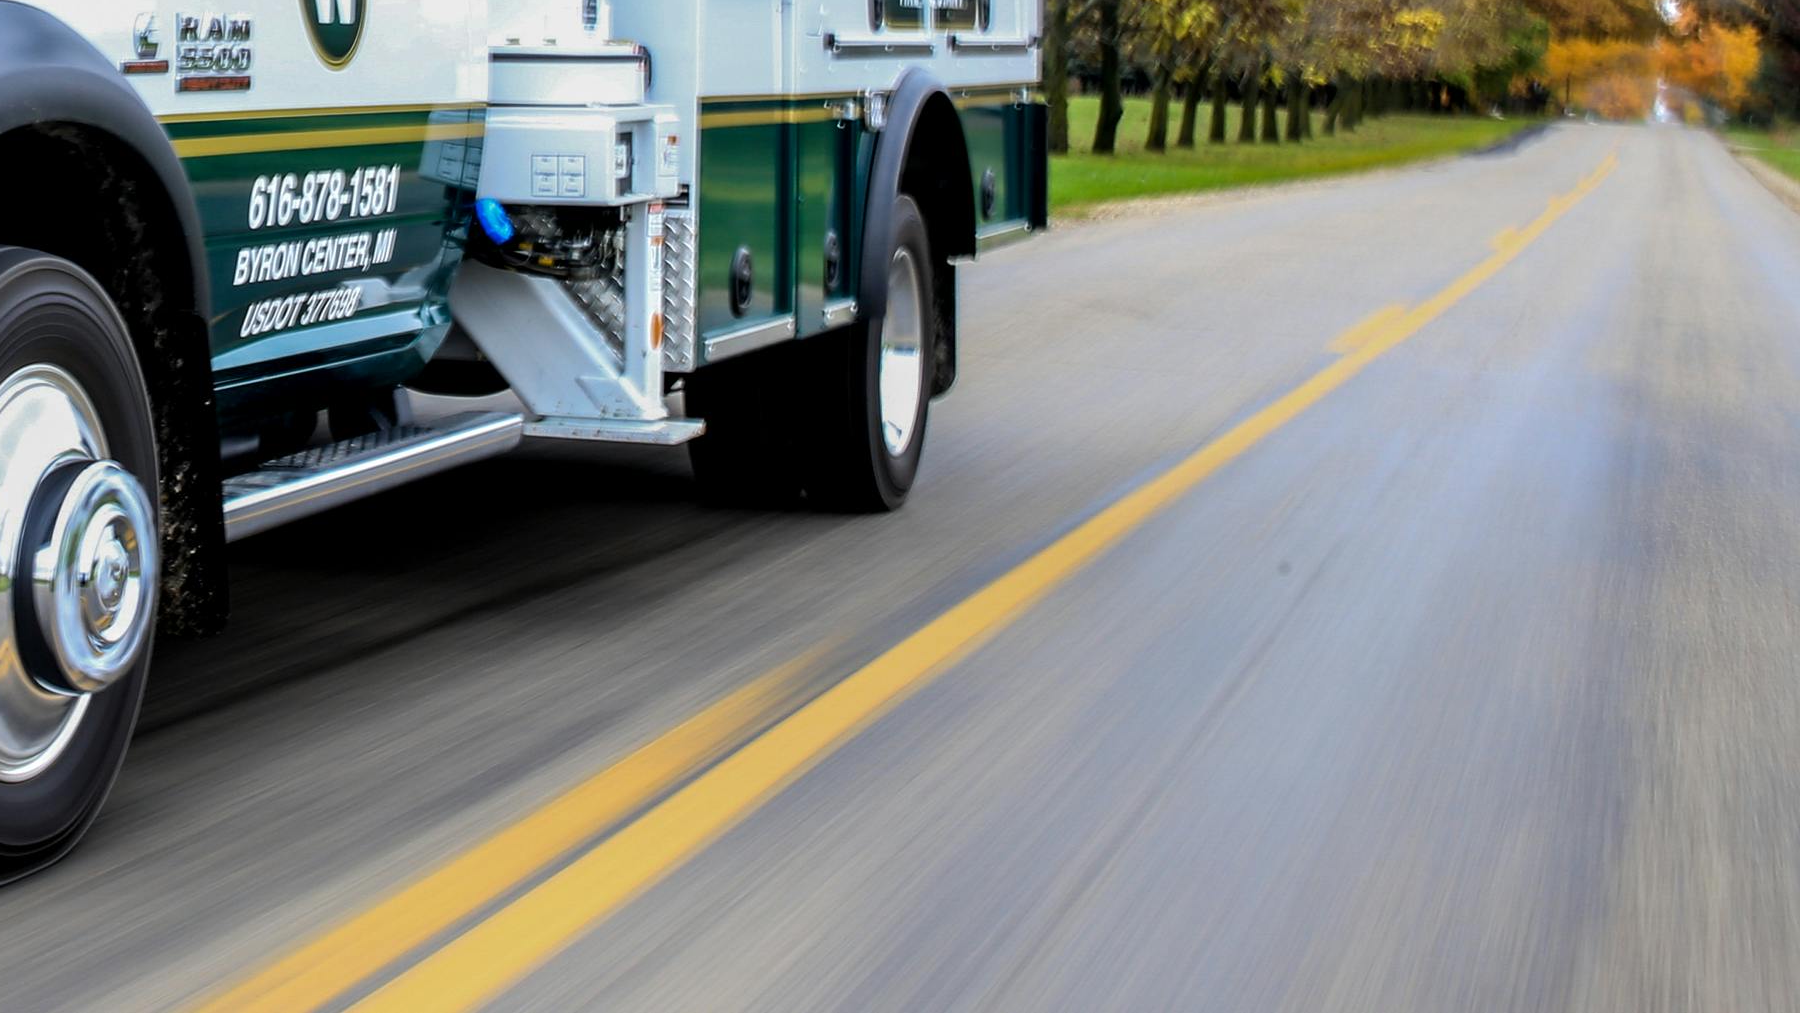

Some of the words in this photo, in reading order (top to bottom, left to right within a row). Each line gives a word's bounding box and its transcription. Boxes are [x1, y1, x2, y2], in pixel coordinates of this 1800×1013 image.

[179, 16, 250, 43] RAM
[178, 46, 251, 72] 5500
[248, 163, 401, 230] 616-878-1581
[232, 240, 303, 286] BYRON
[301, 230, 372, 275] CENTER,
[372, 228, 398, 265] MI
[239, 293, 309, 338] USDOT
[300, 286, 362, 326] 377698
